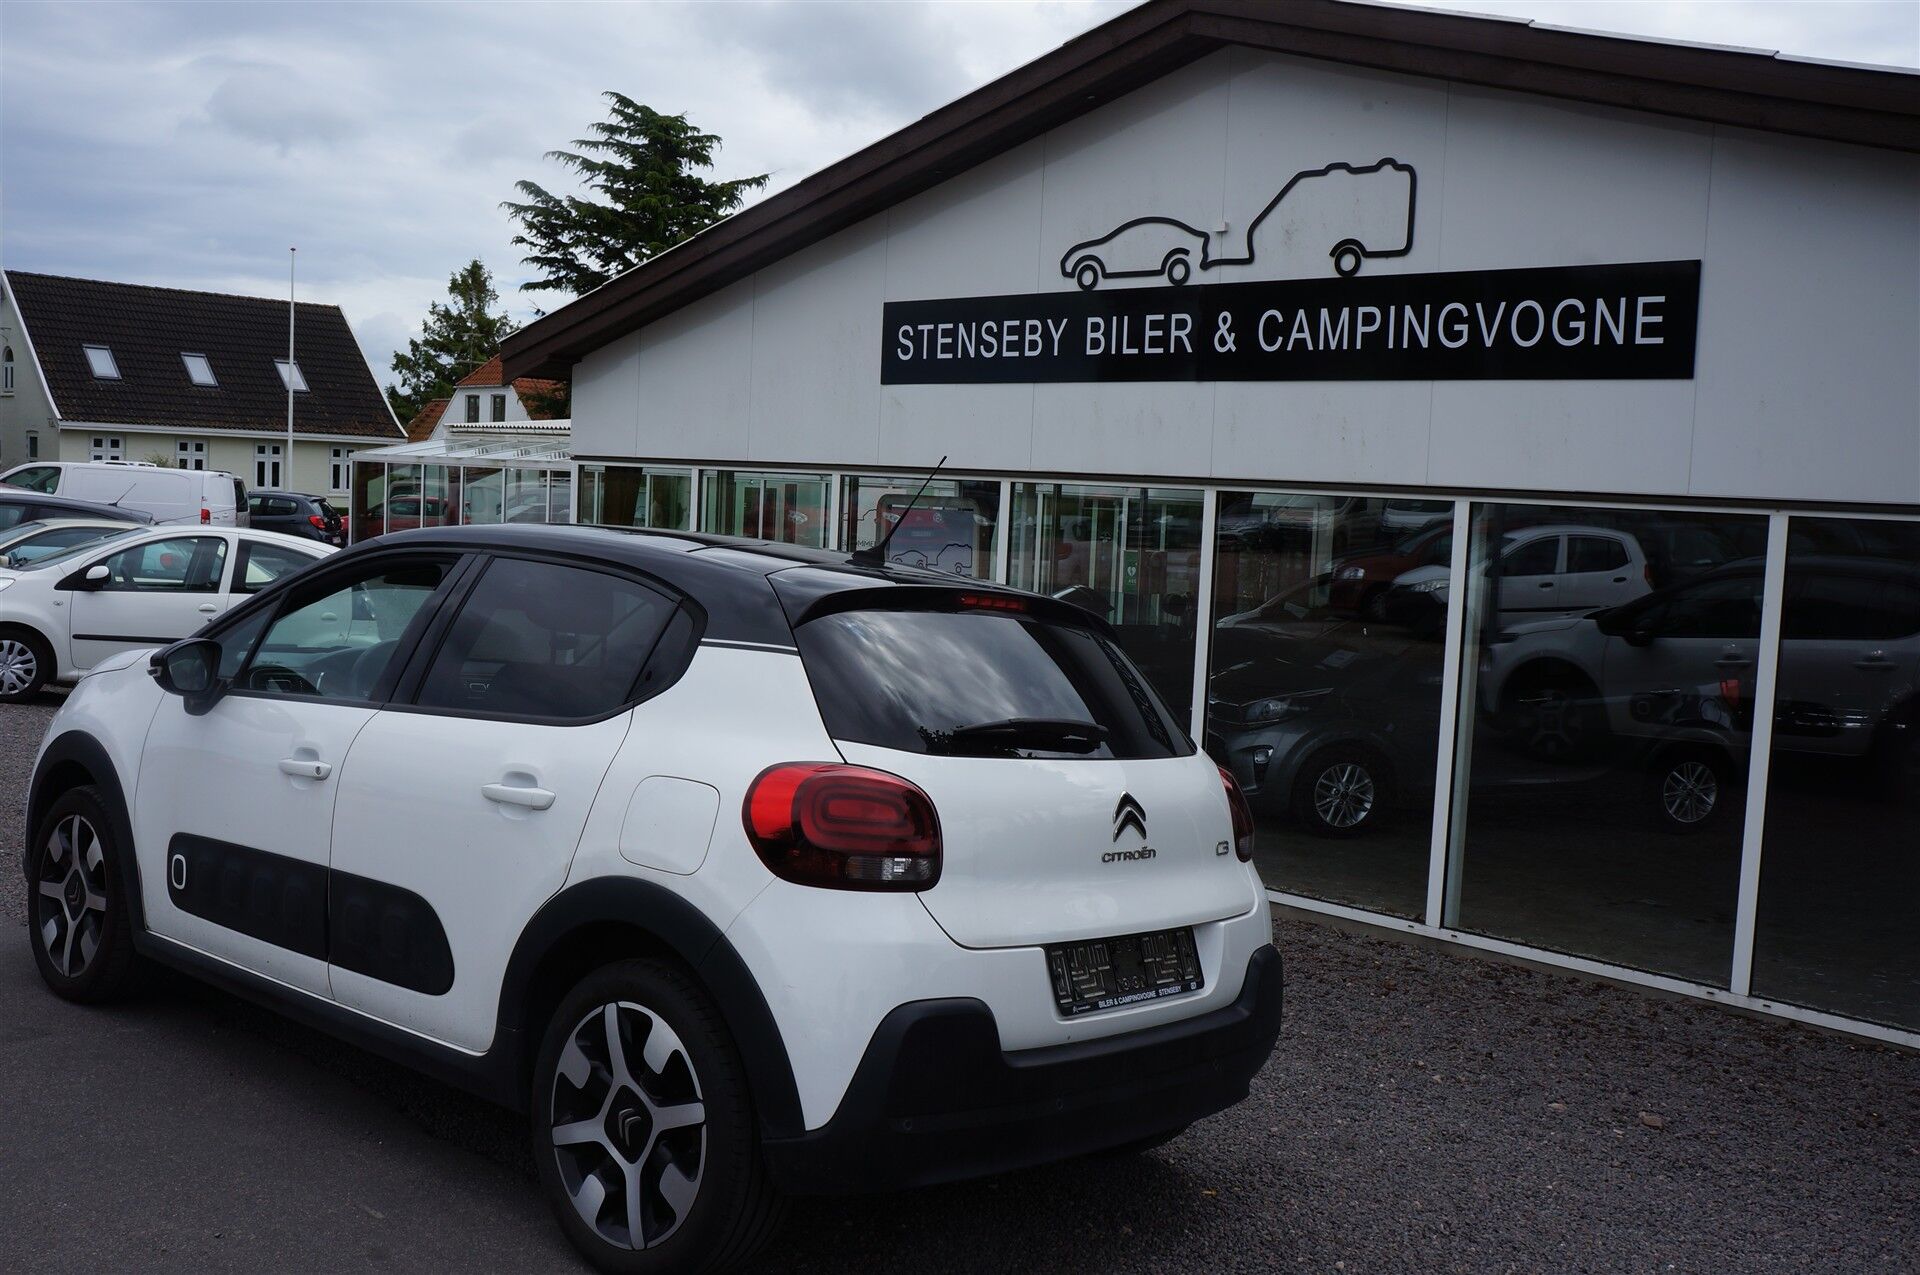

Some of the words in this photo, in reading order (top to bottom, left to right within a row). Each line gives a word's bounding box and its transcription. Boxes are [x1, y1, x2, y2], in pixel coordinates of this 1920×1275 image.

[897, 318, 1068, 361] STENSEBY
[1086, 313, 1193, 355] BILER
[1213, 311, 1237, 353] &
[1258, 295, 1666, 352] CAMPINGVOGNE
[1216, 840, 1230, 857] C3
[1098, 998, 1114, 1008] BILER
[1118, 990, 1156, 1005] CAMPINGVOGNE
[1159, 986, 1182, 996] STENSEBY
